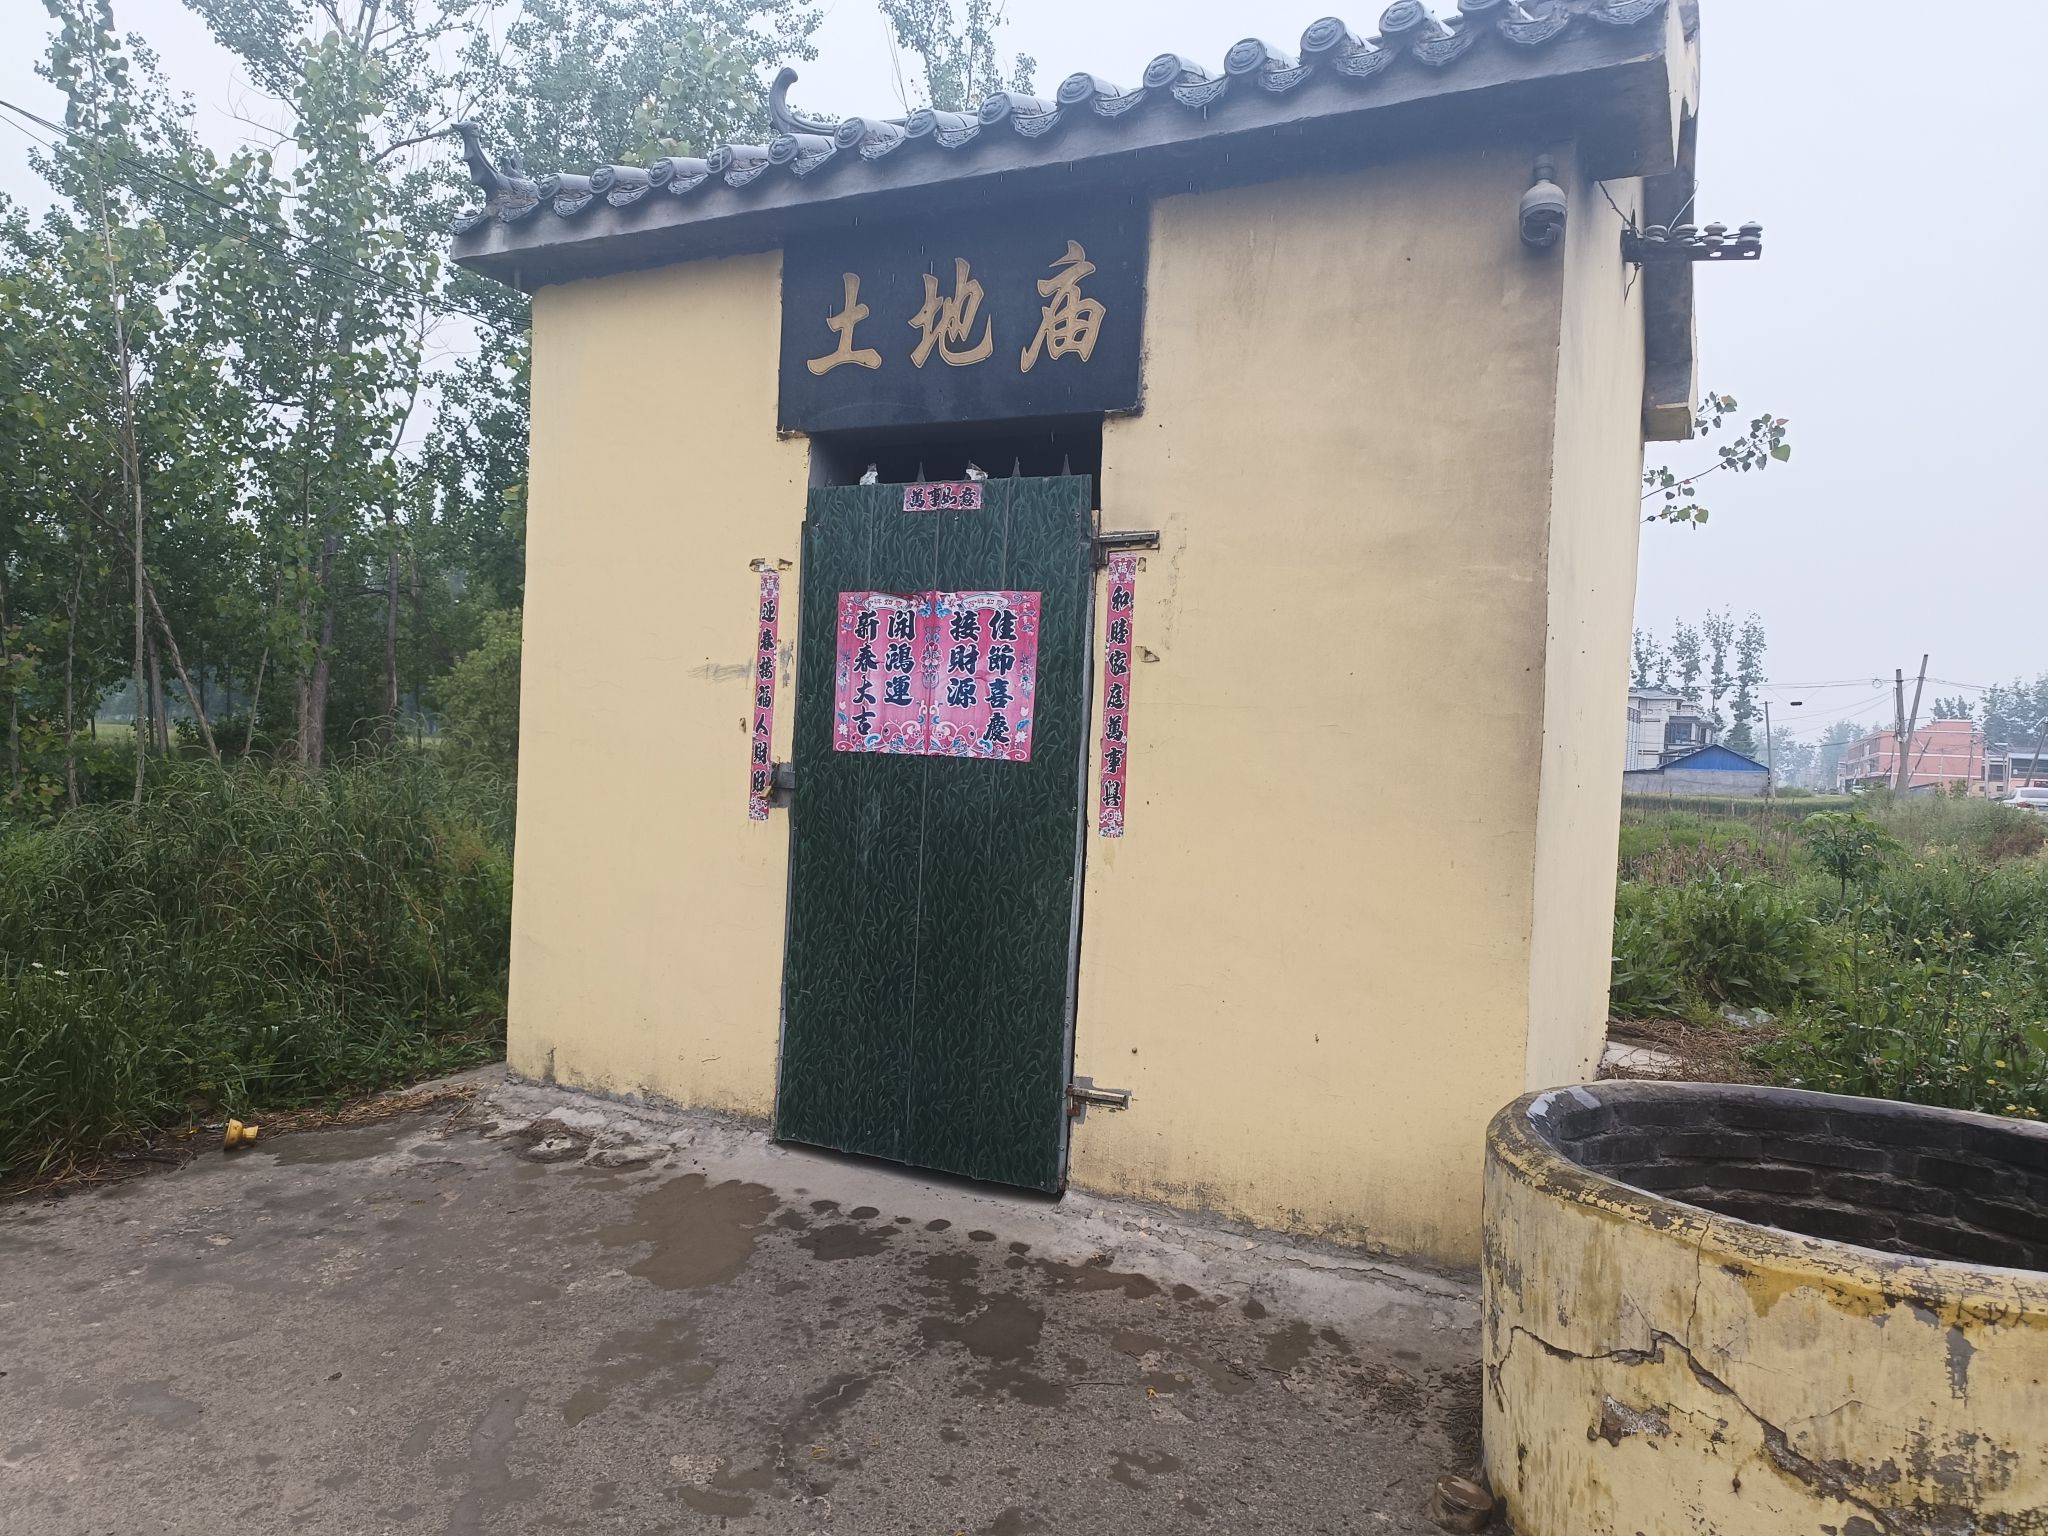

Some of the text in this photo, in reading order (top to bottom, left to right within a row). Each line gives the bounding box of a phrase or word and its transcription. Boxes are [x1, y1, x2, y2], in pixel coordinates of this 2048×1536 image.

[807, 240, 1107, 375] 土地庙
[909, 486, 976, 508] 萬事如意
[852, 610, 880, 736] 新春大吉
[884, 610, 916, 706] 開鴻運
[947, 610, 982, 708] 接財源
[983, 610, 1018, 744] 佳節喜慶
[1103, 585, 1131, 807] 和睦家庭萬事興
